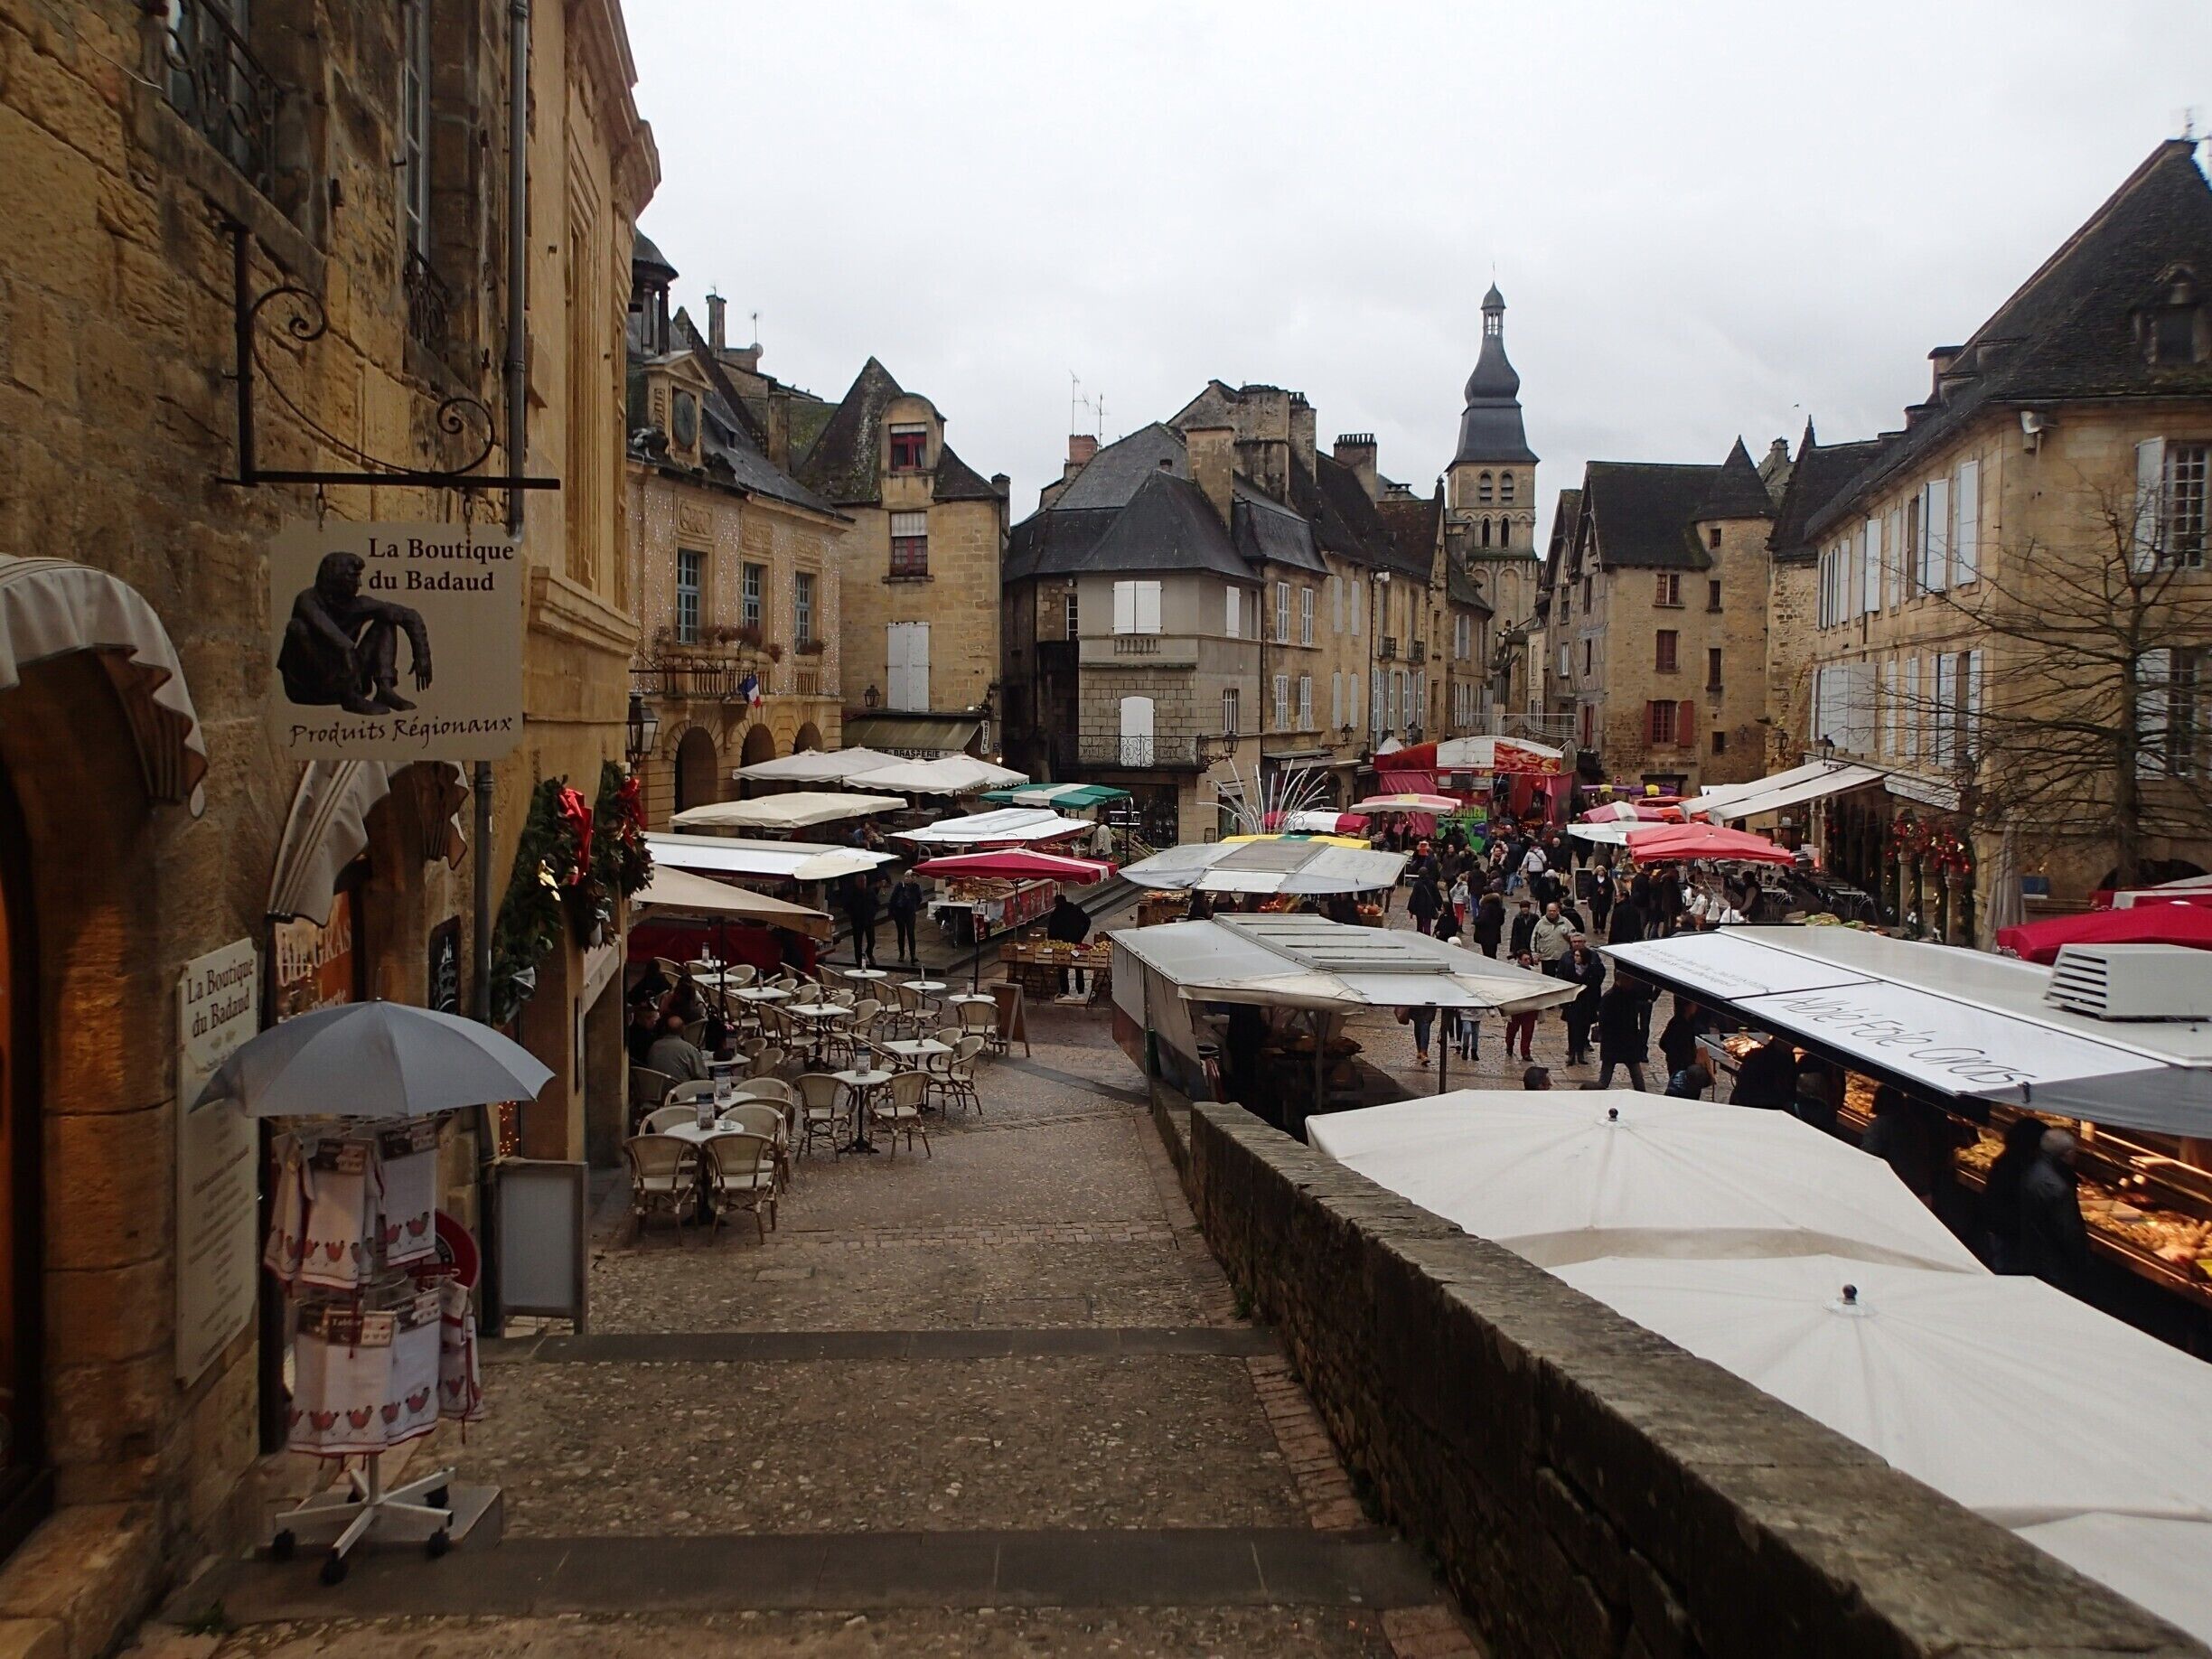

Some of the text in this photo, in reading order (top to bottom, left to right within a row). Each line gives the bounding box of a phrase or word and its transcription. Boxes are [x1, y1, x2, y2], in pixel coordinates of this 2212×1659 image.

[368, 538, 514, 565] La Boutique
[368, 570, 494, 591] du Badaud
[289, 717, 513, 749] Produits Régionaux
[187, 958, 254, 1006] La Boutique
[192, 987, 250, 1038] du Badaud
[1835, 1019, 1936, 1047] Foie
[1907, 1047, 2038, 1084] Gras
